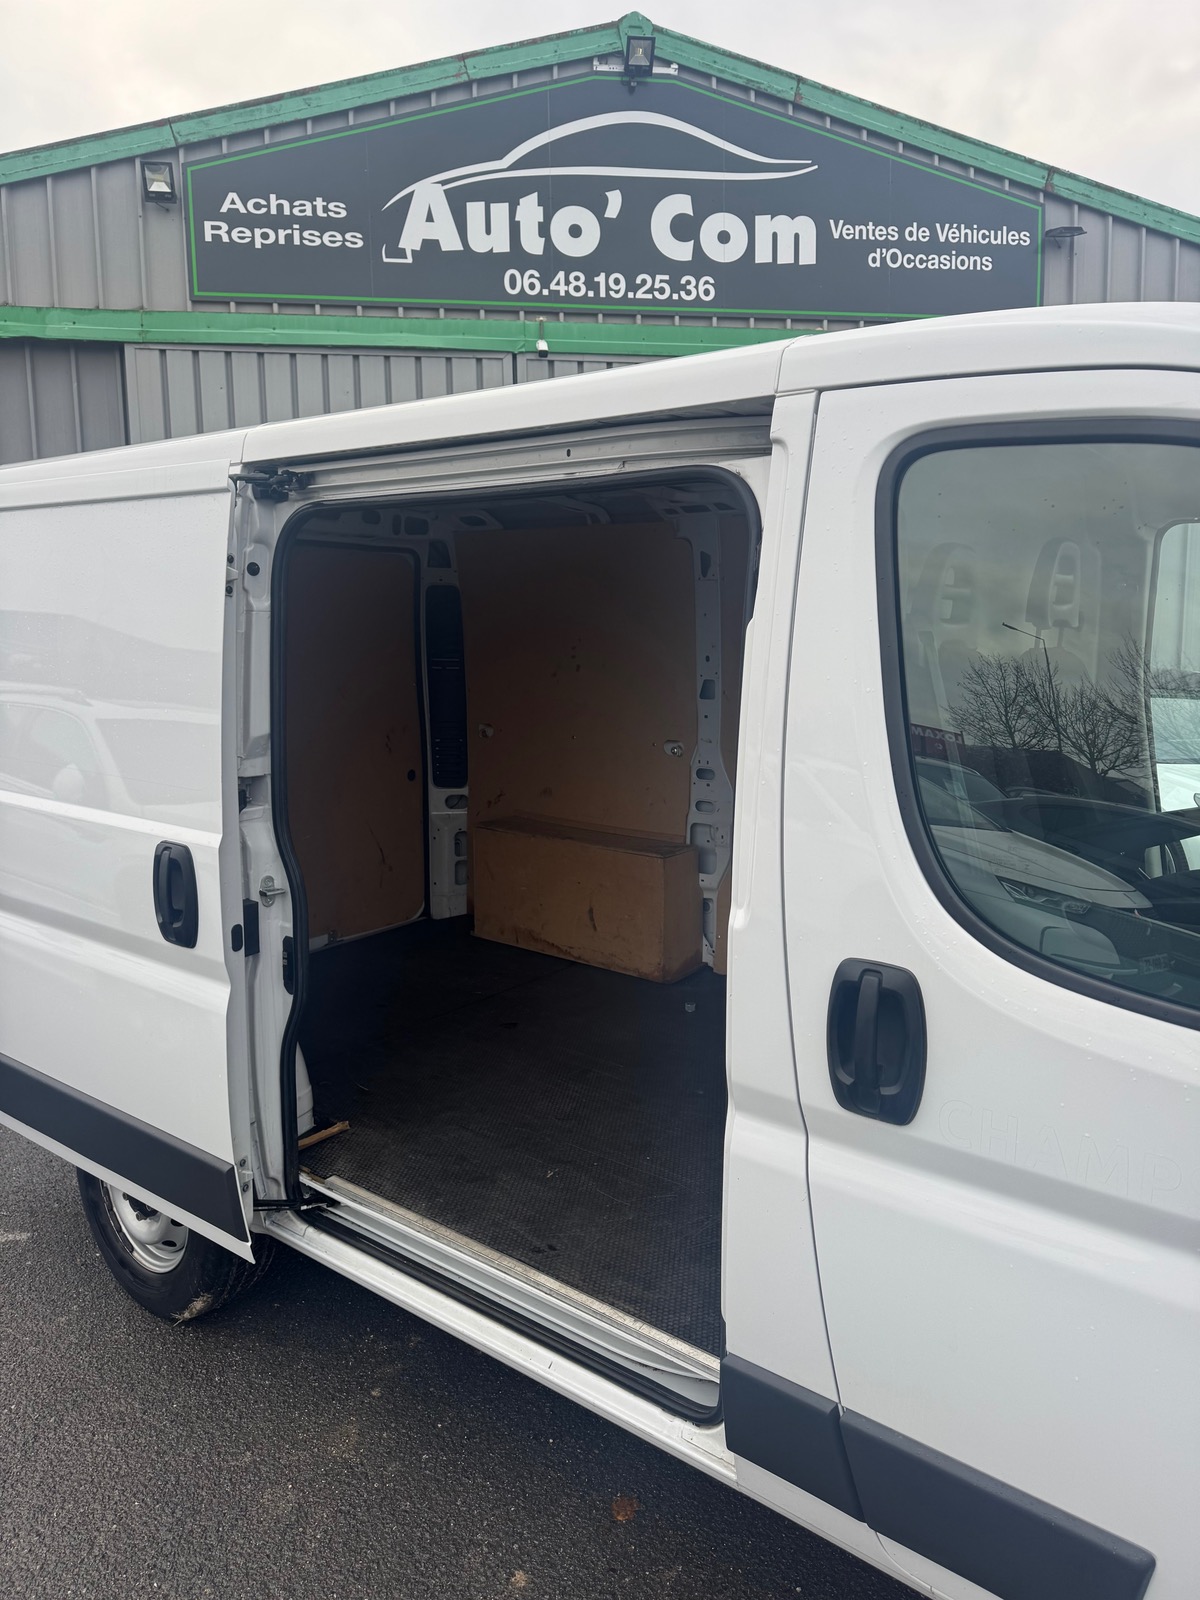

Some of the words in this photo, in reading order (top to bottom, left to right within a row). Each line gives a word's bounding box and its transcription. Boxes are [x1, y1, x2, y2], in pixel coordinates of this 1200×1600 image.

[219, 191, 348, 219] Achats
[203, 220, 364, 249] Reprises
[399, 183, 623, 258] Auto'
[650, 193, 817, 266] Com
[828, 219, 899, 241] Ventes
[904, 221, 931, 243] de
[935, 222, 1031, 246] Véhicules
[867, 247, 993, 272] d'Occasions
[503, 268, 716, 302] 06.48.19.25.36
[938, 1100, 1200, 1204] CHAMP
